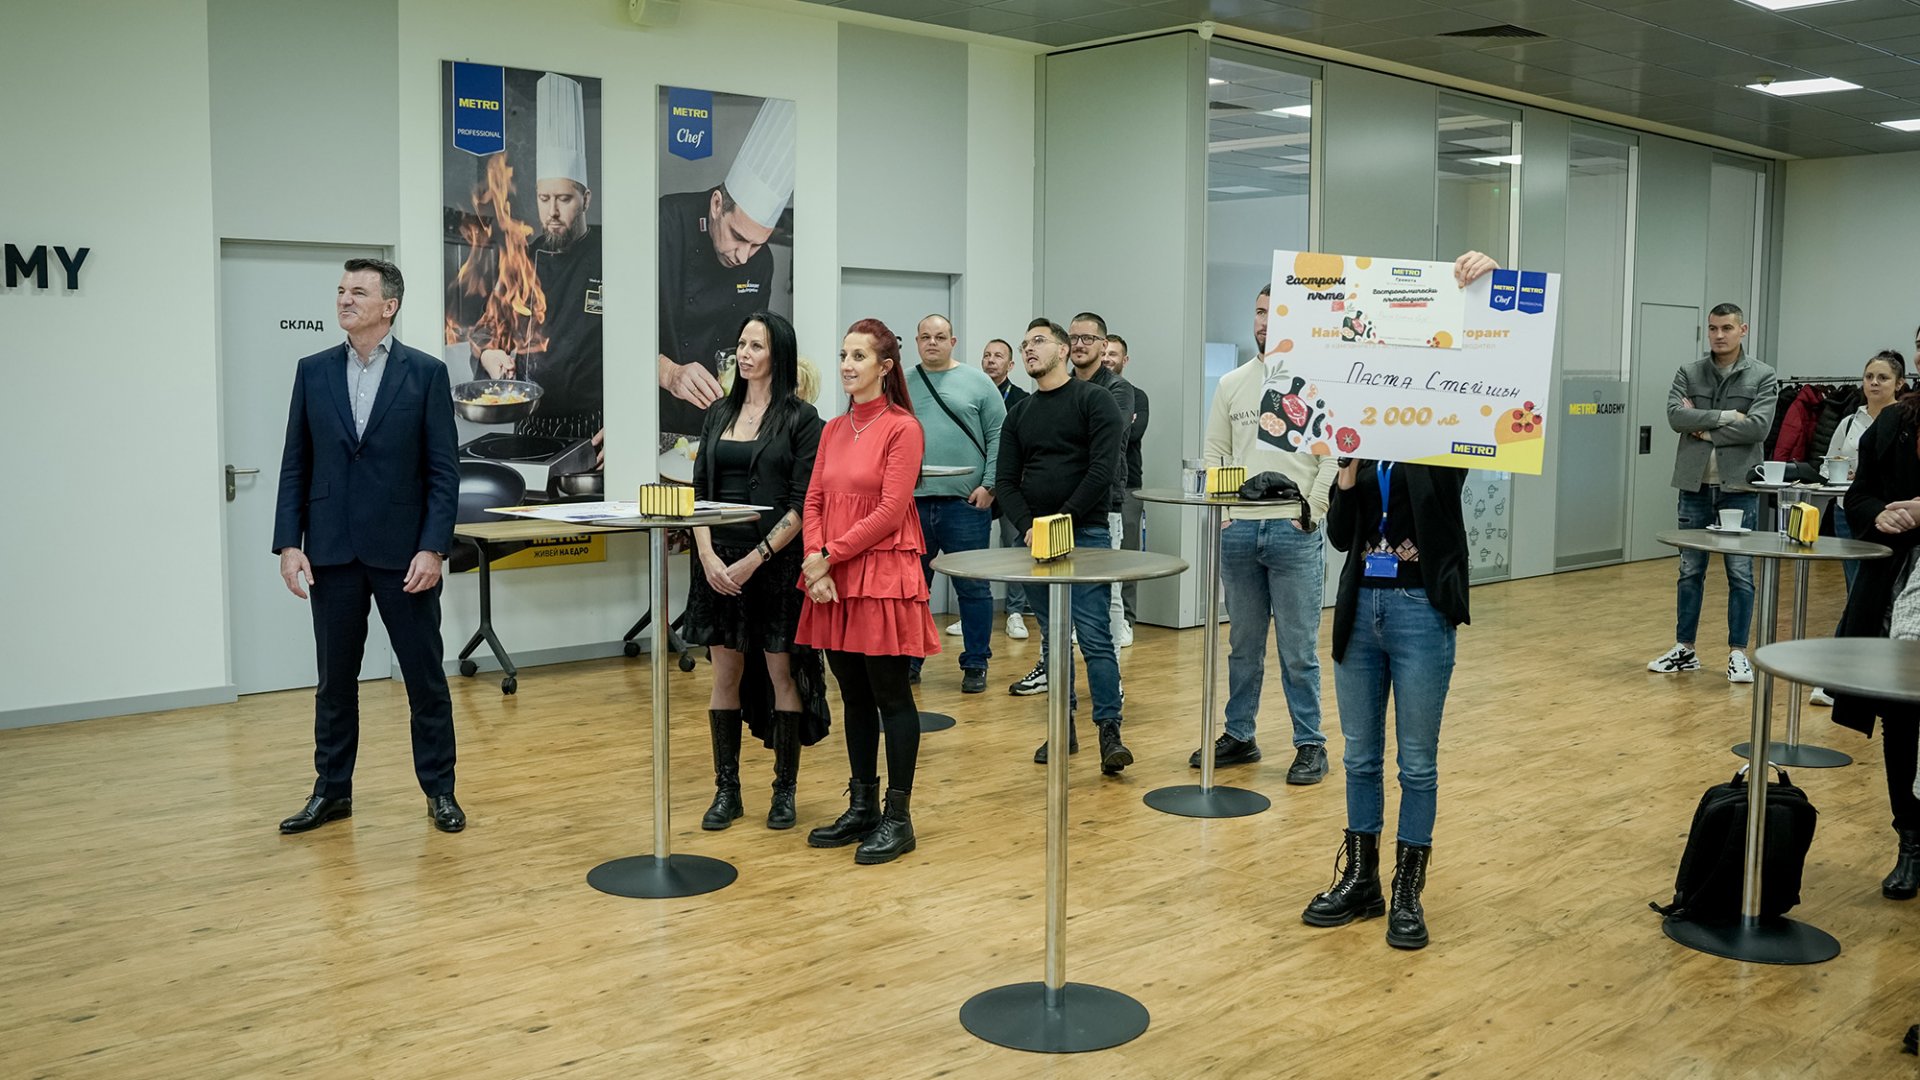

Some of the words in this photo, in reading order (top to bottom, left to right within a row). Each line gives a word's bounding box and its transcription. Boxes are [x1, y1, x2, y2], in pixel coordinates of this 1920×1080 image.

[459, 97, 499, 110] METRO
[673, 106, 708, 119] METRO
[457, 128, 501, 138] PROFESSIONAL
[676, 127, 705, 148] Chef
[1393, 268, 1420, 276] METRO
[1493, 284, 1515, 292] METRO
[1521, 286, 1544, 294] METRO
[1494, 294, 1512, 306] Chef
[280, 319, 324, 332] СКЛАД
[1359, 406, 1378, 426] 2
[1383, 406, 1433, 426] 000
[1437, 414, 1460, 426] лв
[1453, 443, 1495, 456] METRO
[533, 548, 559, 558] ЖИВЕЙ
[560, 548, 569, 556] НА
[570, 547, 589, 557] ЕДРО
